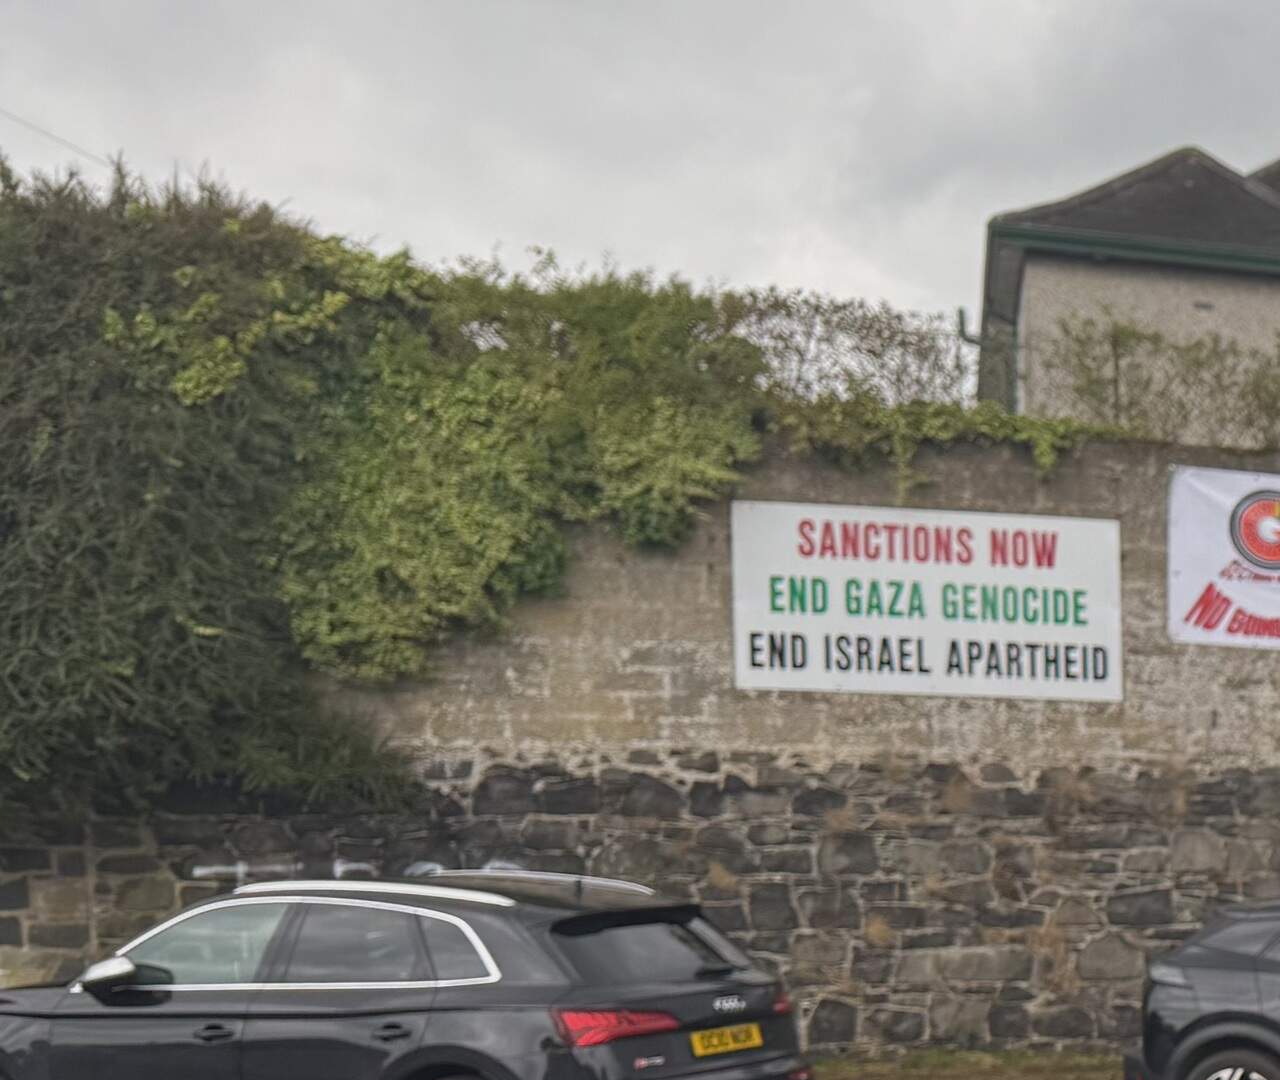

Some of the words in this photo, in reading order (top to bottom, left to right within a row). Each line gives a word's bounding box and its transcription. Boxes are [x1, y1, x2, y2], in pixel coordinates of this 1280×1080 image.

[798, 519, 973, 565] SANCTIONS
[990, 530, 1058, 568] NOW
[769, 575, 828, 615] END
[846, 578, 925, 619] GAZA
[943, 584, 1089, 625] GENOCIDE
[1184, 582, 1233, 631] NO
[749, 631, 807, 670] END
[824, 634, 931, 675] ISRAEL
[946, 640, 1109, 681] APARTHEID
